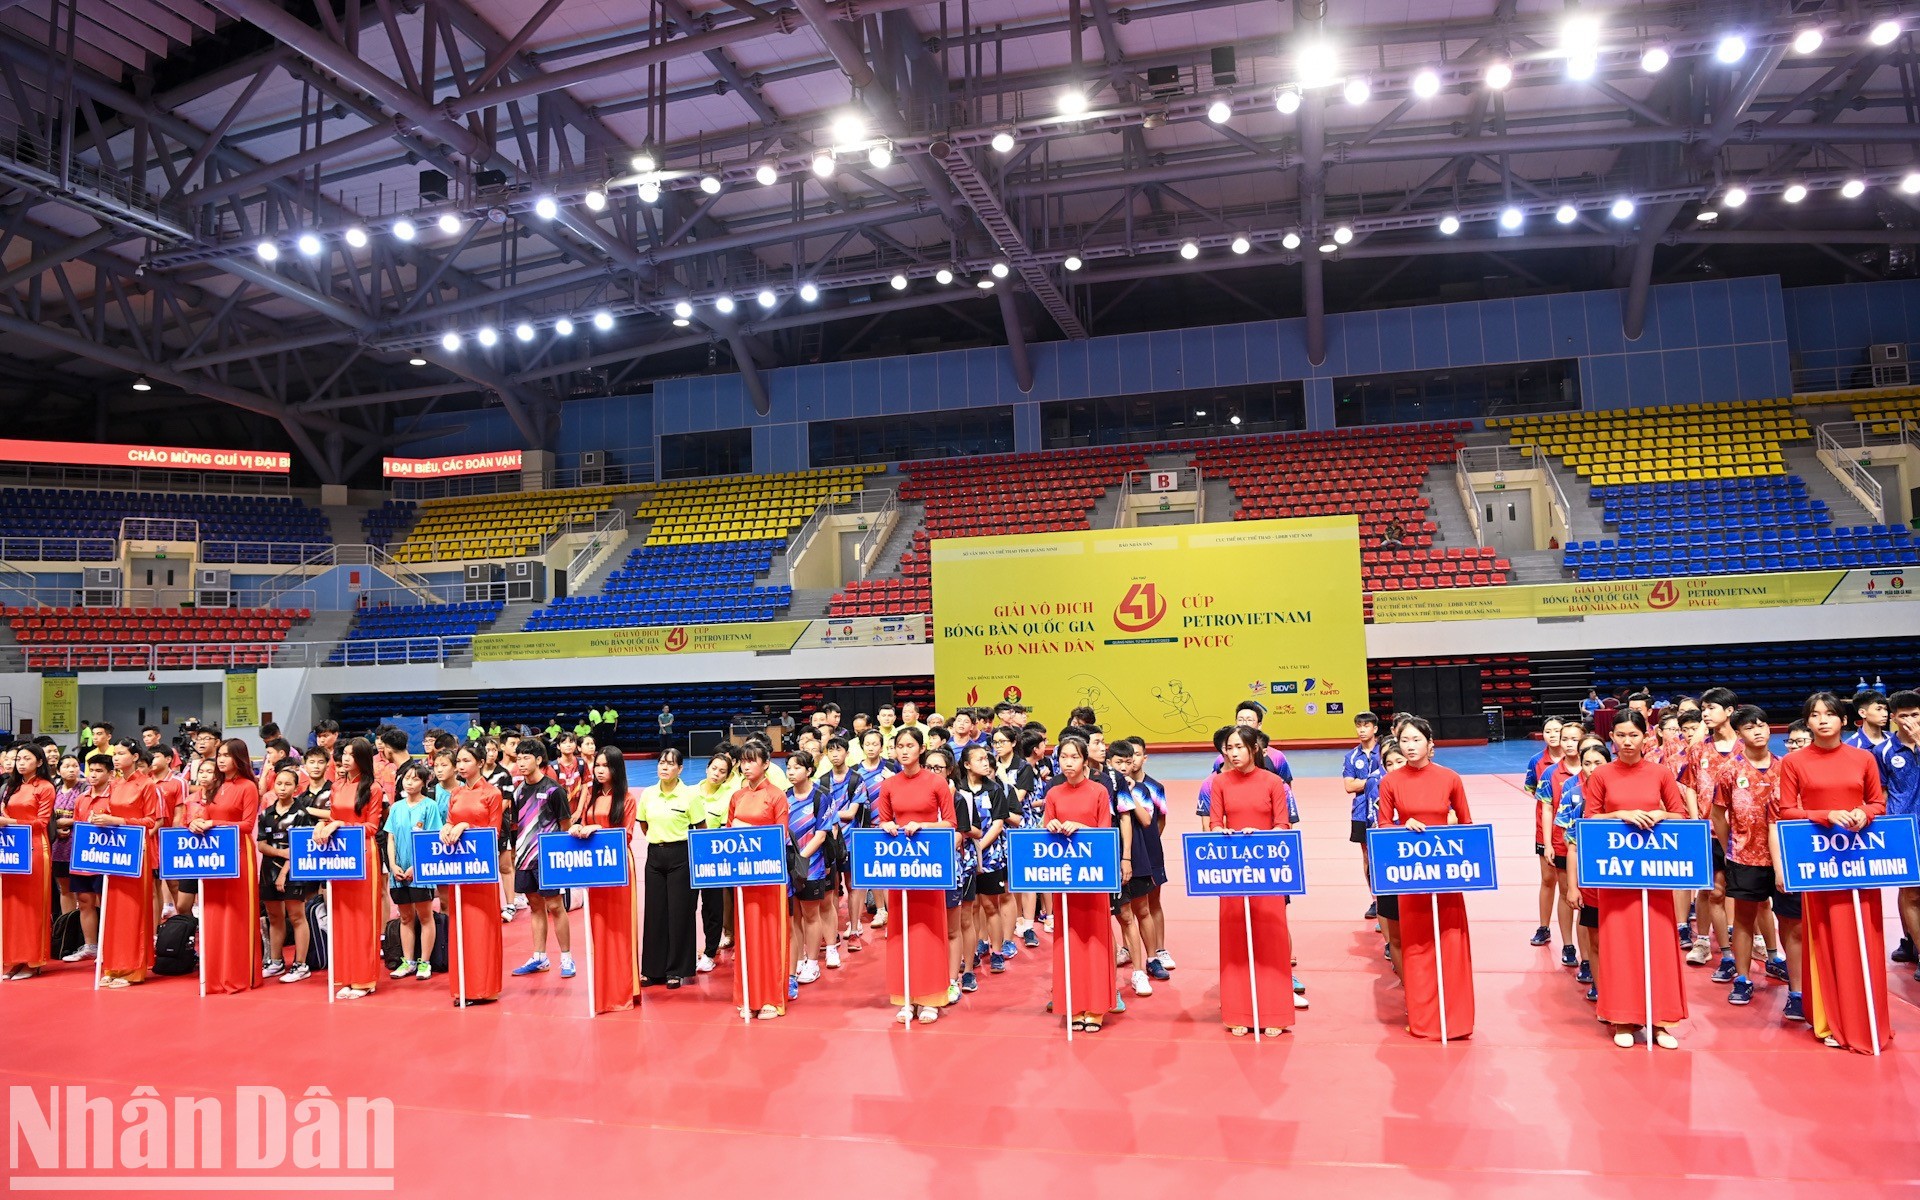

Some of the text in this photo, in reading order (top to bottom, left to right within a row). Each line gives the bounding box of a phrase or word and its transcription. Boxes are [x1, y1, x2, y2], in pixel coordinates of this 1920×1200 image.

[128, 449, 168, 462] CHÀO
[171, 450, 211, 464] MỪNG
[214, 453, 237, 466] QUÍ
[240, 456, 252, 468] VỊ
[255, 456, 276, 470] ĐẠI
[392, 462, 412, 475] ĐẠI
[442, 459, 463, 471] CÁC
[465, 456, 493, 469] ĐOÀN
[495, 455, 515, 468] VẬN
[1158, 475, 1170, 488] B
[1651, 581, 1673, 602] 41
[1687, 579, 1707, 588] CÚP
[1688, 587, 1767, 598] PETROVIETNAM
[1120, 583, 1156, 619] 41
[1181, 594, 1214, 608] CÚP
[1543, 595, 1569, 604] BÓNG
[1594, 593, 1620, 603] QUỐC
[1569, 603, 1588, 612] BÁO
[994, 602, 1025, 617] GIẢI
[1056, 602, 1093, 616] ĐỊCH
[944, 618, 1095, 637] BÓNG BÀN QUỐC GIA
[1183, 610, 1312, 628] PETROVIETNAM
[668, 627, 684, 646] 41
[694, 634, 752, 642] PETROVIETNAM
[1184, 635, 1234, 648] PVCFC
[984, 638, 1095, 656] BÁO NHÂN DÂN
[148, 672, 155, 682] 4
[89, 830, 127, 847] ĐOÀN
[711, 834, 762, 855] ĐOÀN
[874, 837, 930, 857] ĐOÀN
[1397, 835, 1464, 858] ĐOÀN
[81, 848, 131, 866] ĐỒNG NAI
[1033, 837, 1093, 859] ĐOÀN
[1195, 840, 1290, 862] CÂU LẠC BỘ
[173, 852, 225, 870] HÀ NỘI
[298, 854, 356, 870] HẢI PHÒNG
[422, 858, 489, 876] KHÁNH HÒA
[548, 845, 617, 872] TRỌNG TÀI
[695, 857, 781, 878] LONG HẢI HẢI DƯƠNG
[1596, 856, 1693, 877] TÂY NINH
[1798, 855, 1908, 880] TP HỒ CHÍ MINH
[864, 859, 942, 878] LÂM ĐỒNG
[1024, 864, 1103, 885] NGHỆ AN
[1270, 865, 1292, 883] VÕ
[1386, 859, 1480, 882] QUÂN ĐỘI
